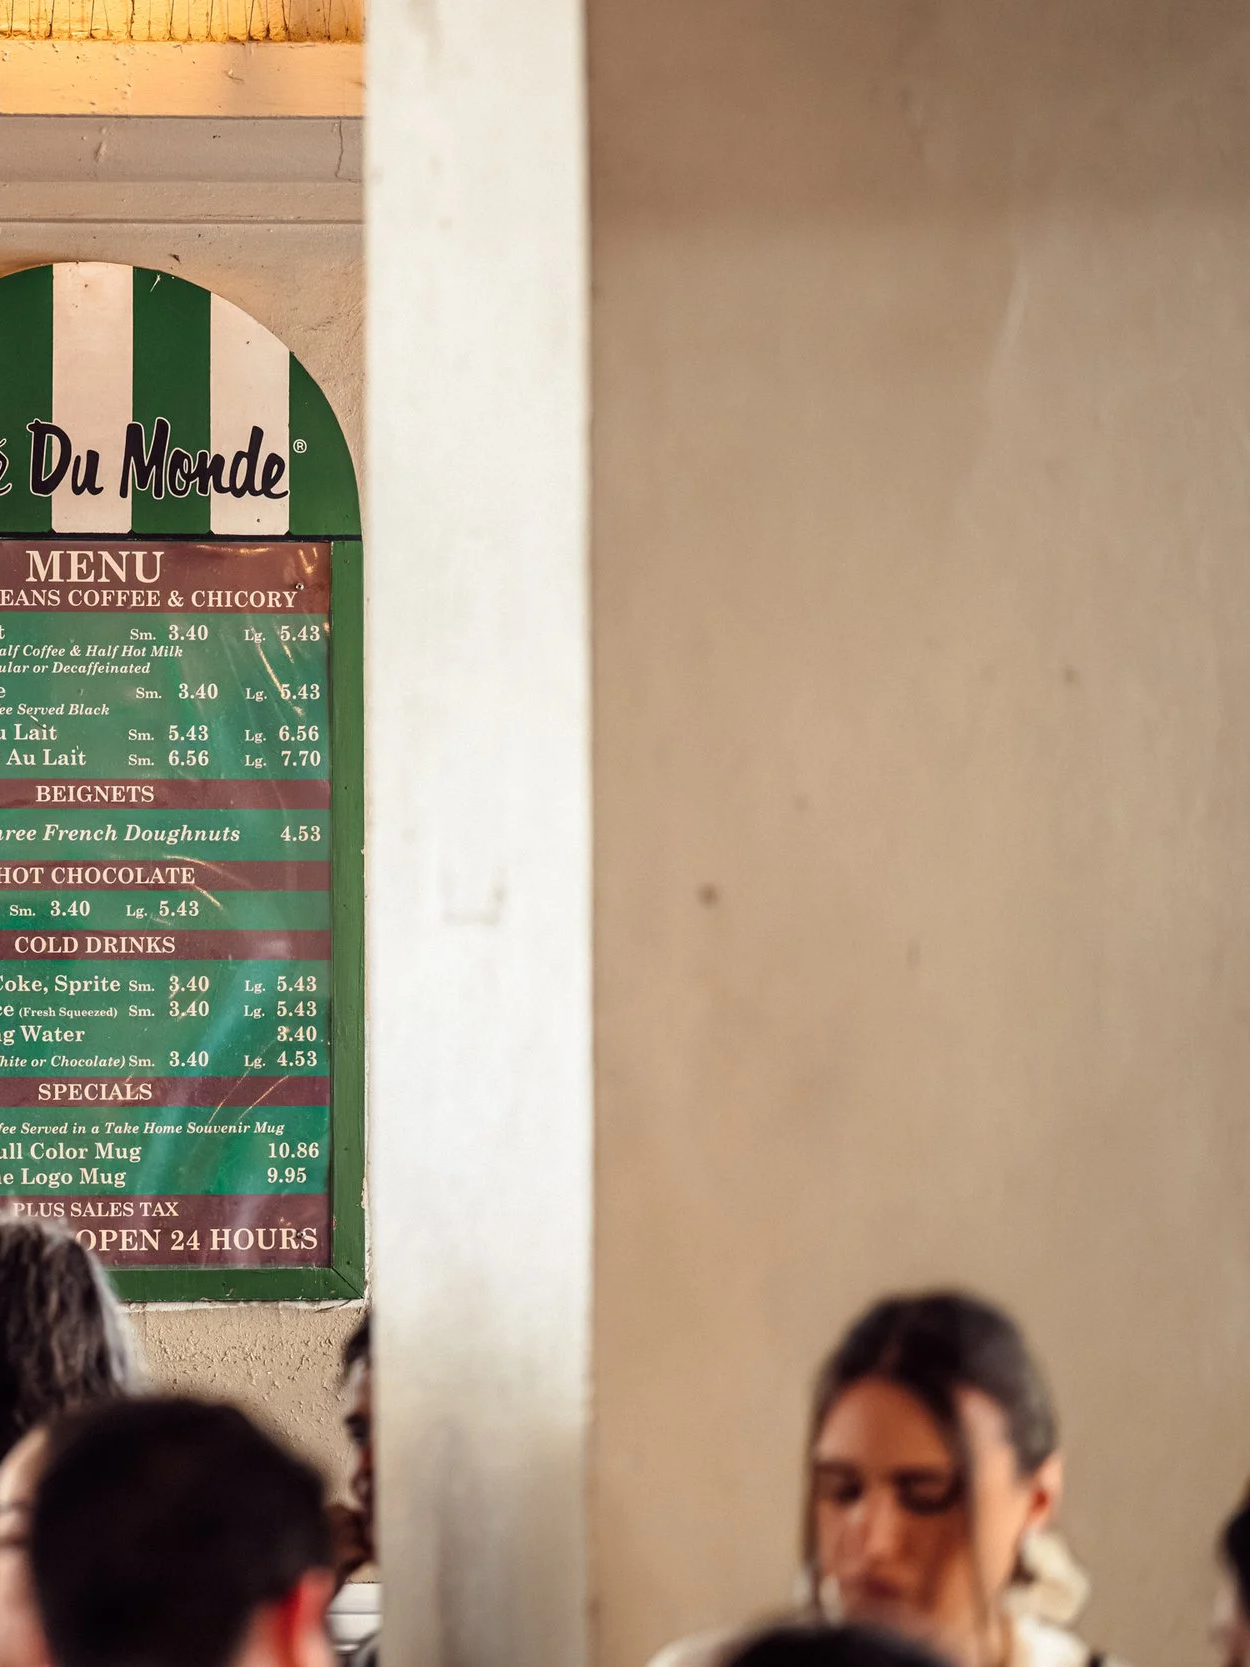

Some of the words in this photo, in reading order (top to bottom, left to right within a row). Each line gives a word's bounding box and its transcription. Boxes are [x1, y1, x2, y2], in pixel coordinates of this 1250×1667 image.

[27, 418, 104, 498] Du
[119, 416, 290, 500] Monde
[25, 550, 165, 583] MENU
[67, 589, 160, 607] COFFEE
[167, 591, 184, 607] &
[190, 590, 297, 608] CHICORY
[130, 628, 156, 641] Sm.
[168, 625, 209, 641] 3.40
[244, 629, 266, 643] Lg.
[279, 624, 321, 642] 5.43
[22, 644, 65, 660] Coffee
[70, 645, 81, 657] &
[85, 645, 118, 660] Half
[121, 645, 147, 658] Hot
[150, 645, 183, 658] Milk
[32, 664, 49, 674] or
[51, 661, 150, 676] Decaffeinated
[135, 687, 162, 699] Sm.
[178, 683, 219, 700] 3.40
[245, 687, 267, 702] Lg.
[279, 683, 321, 701] 5.43
[16, 703, 65, 716] Served
[68, 703, 110, 716] Black
[14, 724, 57, 741] Lait
[128, 729, 154, 741] Sm.
[168, 725, 209, 741] 5.43
[244, 730, 266, 744] Lg.
[278, 724, 320, 742] 6.56
[6, 750, 36, 766] Au
[42, 750, 86, 766] Lait
[128, 754, 154, 766] Sm.
[168, 750, 209, 766] 6.56
[244, 755, 267, 769] Lg.
[280, 750, 321, 768] 7.70
[35, 785, 154, 803] BEIGNETS
[43, 824, 118, 842] French
[123, 824, 241, 845] Doughnuts
[280, 825, 322, 842] 4.53
[50, 867, 196, 885] CHOCOLATE
[9, 904, 36, 917] Sm.
[50, 901, 90, 917] 3.40
[125, 905, 148, 920] Lg.
[158, 900, 199, 917] 5.43
[14, 936, 79, 954] COLD
[84, 936, 175, 954] DRINKS
[54, 974, 121, 997] Sprite
[128, 980, 155, 993] Sm.
[169, 975, 210, 993] 3.40
[244, 980, 266, 996] Lg.
[276, 976, 318, 993] 5.43
[19, 1006, 57, 1019] (Fresh
[58, 1006, 118, 1020] Squeezed)
[128, 1005, 155, 1018] Sm.
[169, 1001, 210, 1018] 3.40
[243, 1005, 266, 1021] Lg.
[276, 1001, 318, 1018] 5.43
[20, 1026, 86, 1043] Water
[276, 1026, 318, 1043] 3.40
[30, 1058, 47, 1069] or
[50, 1055, 126, 1070] Chocolate)
[128, 1056, 155, 1068] Sm.
[169, 1051, 209, 1068] 3.40
[244, 1056, 266, 1071] Lg.
[276, 1051, 318, 1068] 4.53
[38, 1083, 153, 1102] SPECIALS
[20, 1122, 68, 1135] Served
[72, 1123, 87, 1135] in
[91, 1126, 100, 1135] a
[104, 1122, 139, 1135] Take
[143, 1122, 182, 1135] Home
[186, 1122, 250, 1135] Souvenir
[254, 1122, 284, 1137] Mug
[28, 1142, 88, 1160] Color
[94, 1142, 142, 1163] Mug
[268, 1142, 319, 1159] 10.86
[21, 1168, 73, 1189] Logo
[79, 1168, 127, 1188] Mug
[267, 1167, 307, 1184] 9.95
[14, 1202, 65, 1218] PLUS
[70, 1202, 134, 1218] SALES
[139, 1202, 179, 1217] TAX
[75, 1229, 161, 1252] OPEN
[170, 1229, 200, 1252] 24
[209, 1228, 318, 1250] HOURS
